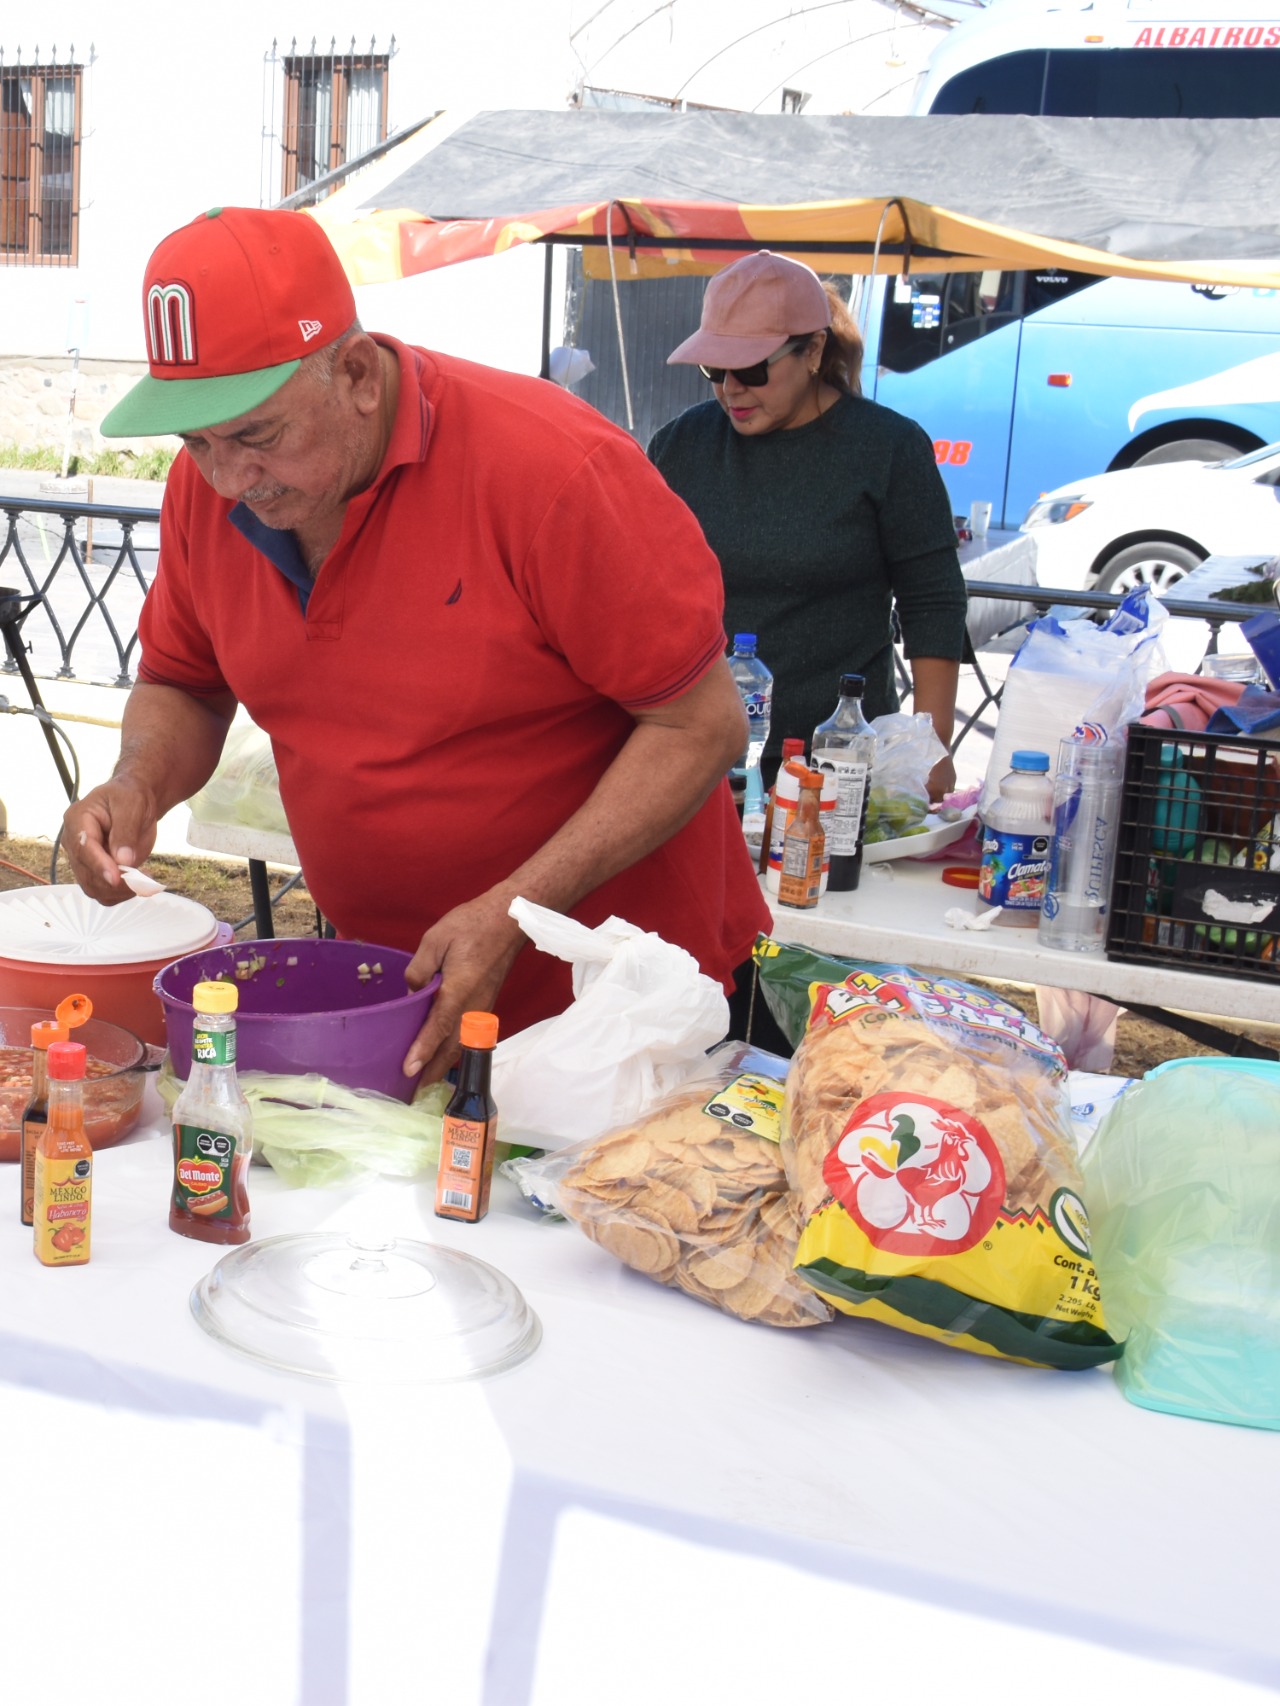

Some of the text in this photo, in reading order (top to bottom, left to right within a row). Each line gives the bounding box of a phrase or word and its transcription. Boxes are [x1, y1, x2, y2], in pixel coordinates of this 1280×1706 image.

[1132, 26, 1280, 48] ALBATROS
[1035, 275, 1069, 284] VOLVO
[1007, 860, 1052, 880] Clamato
[907, 991, 1063, 1055] GALL
[179, 1168, 220, 1182] Del Monte
[54, 1193, 83, 1203] LINDO
[49, 1208, 88, 1221] Habanero
[1053, 1254, 1085, 1274] Cont.
[1070, 1275, 1101, 1301] 1 kg
[1058, 1293, 1083, 1306] 2.205
[1055, 1304, 1070, 1314] Net
